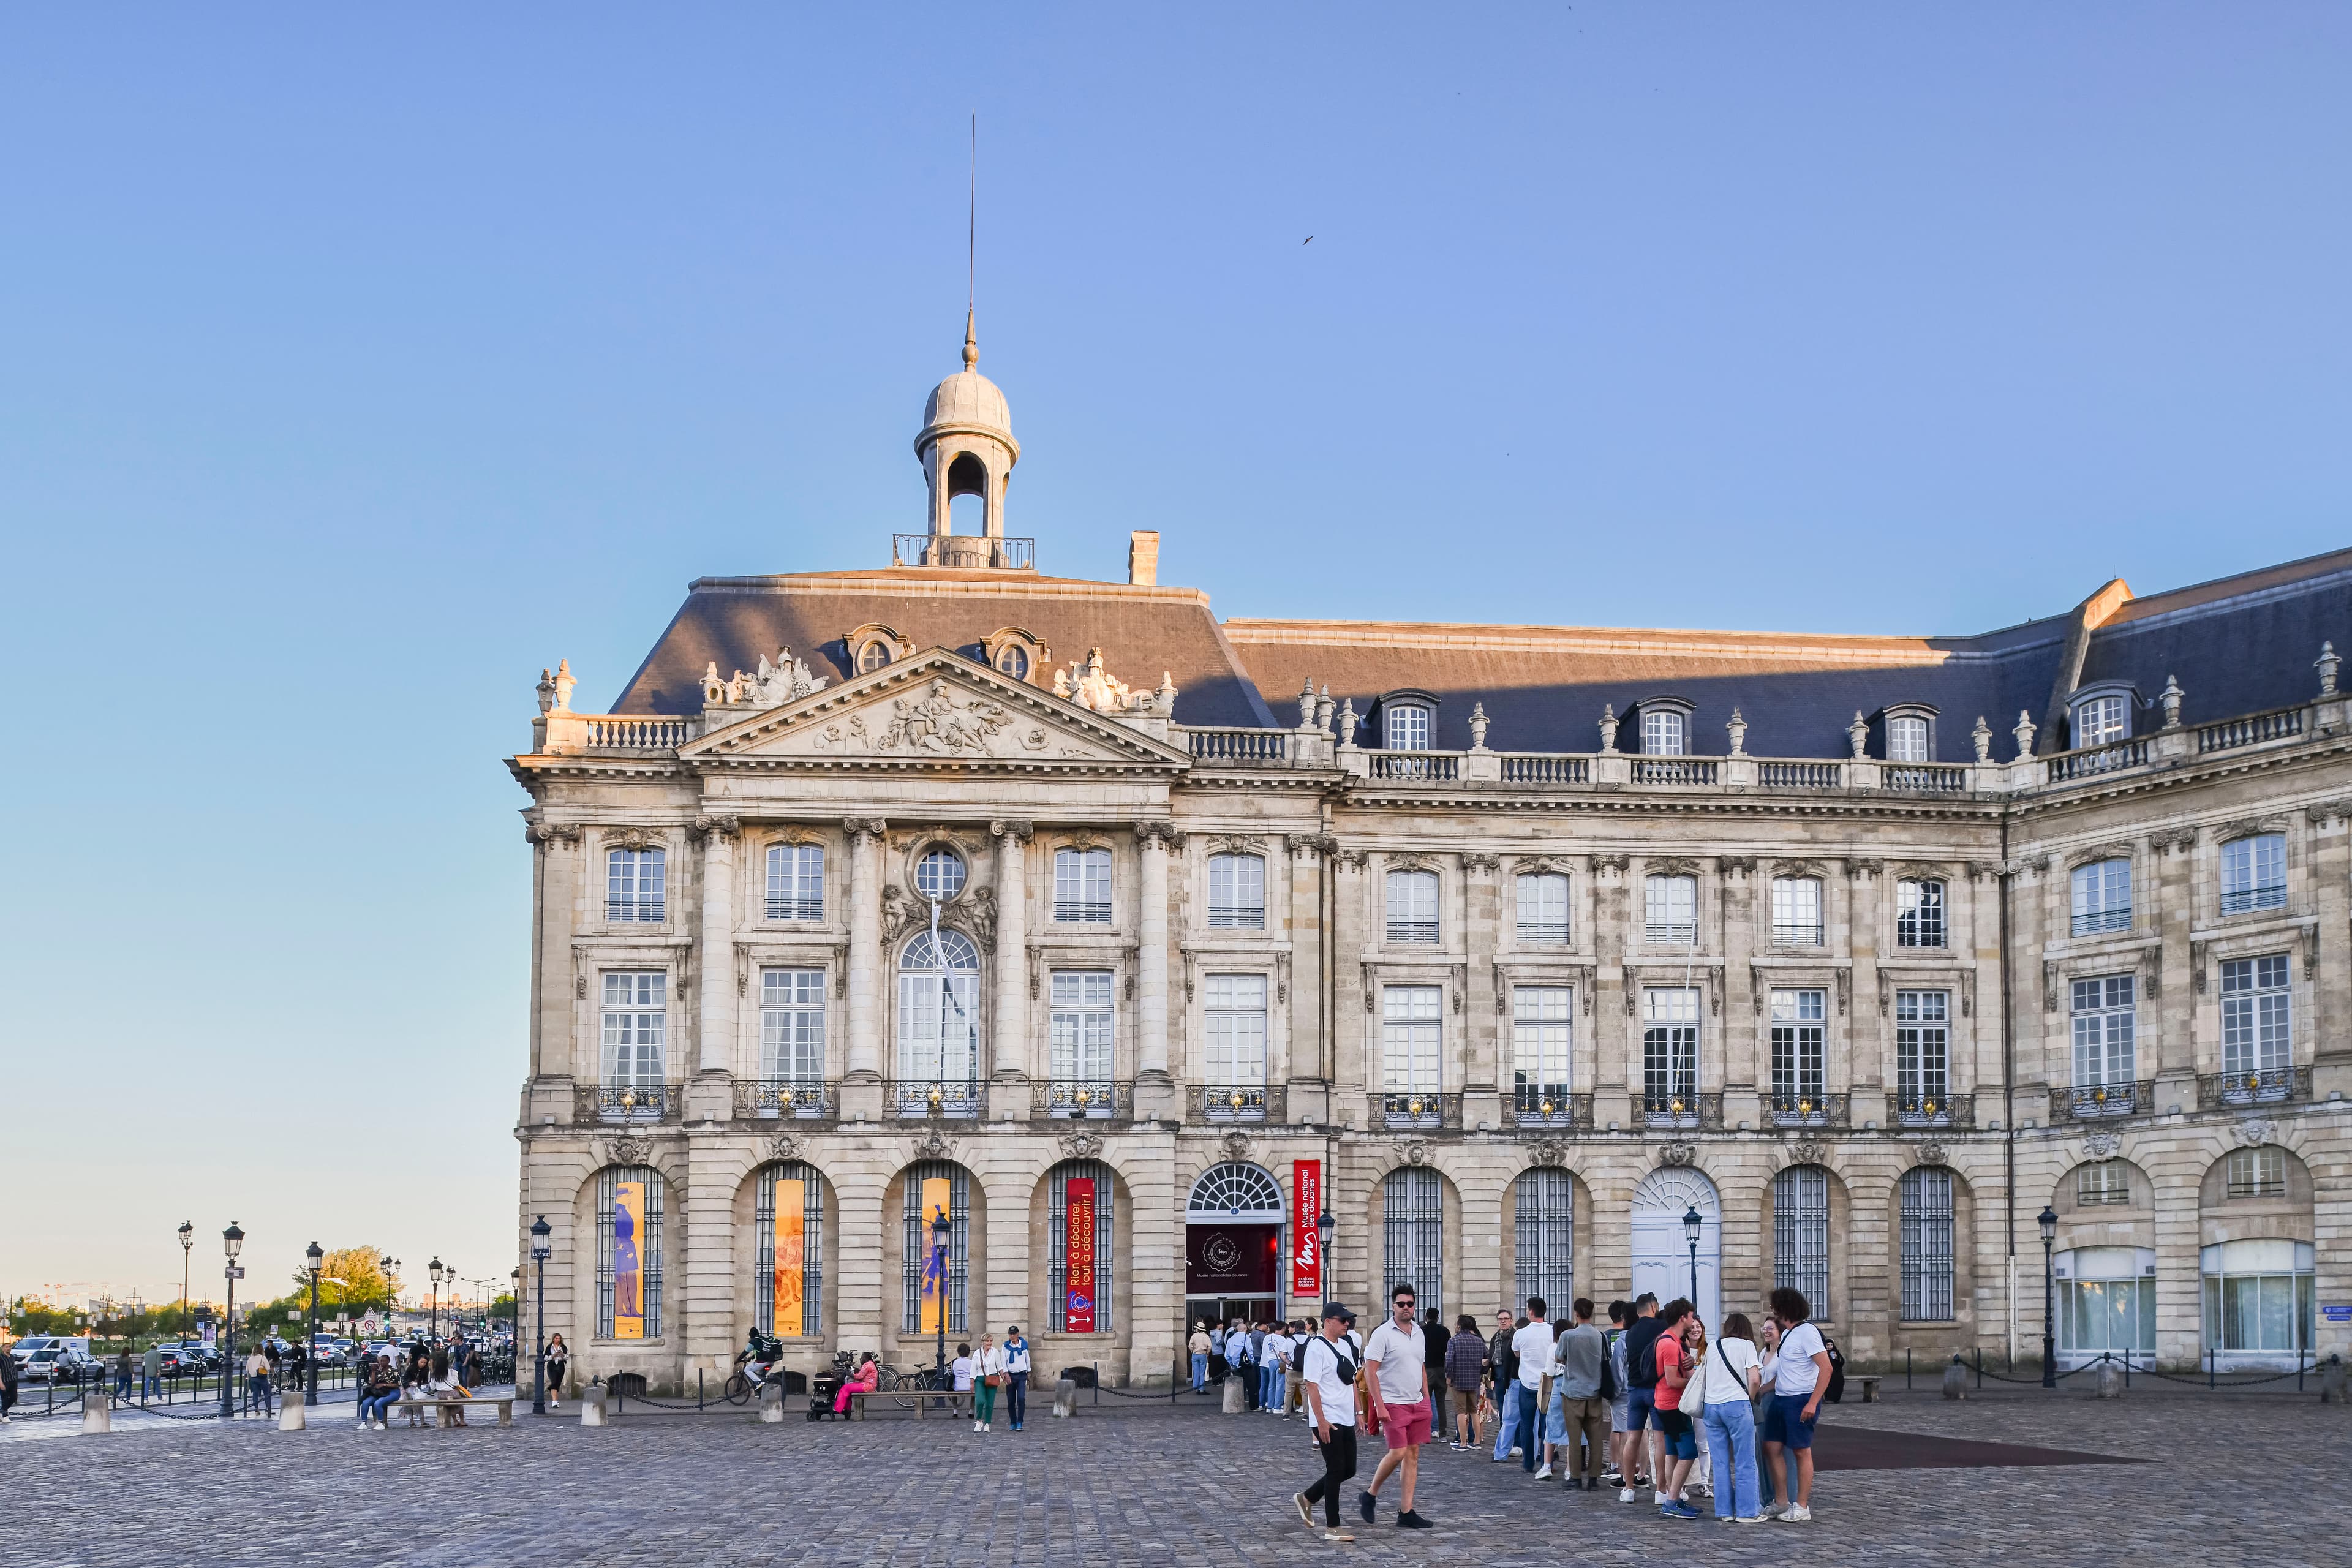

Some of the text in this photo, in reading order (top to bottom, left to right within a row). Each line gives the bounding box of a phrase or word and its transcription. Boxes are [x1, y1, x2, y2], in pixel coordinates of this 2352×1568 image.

[1070, 1201, 1081, 1248] déclarer,
[1081, 1199, 1090, 1251] découvrir
[1070, 1262, 1079, 1286] Rien
[1081, 1265, 1090, 1286] tout
